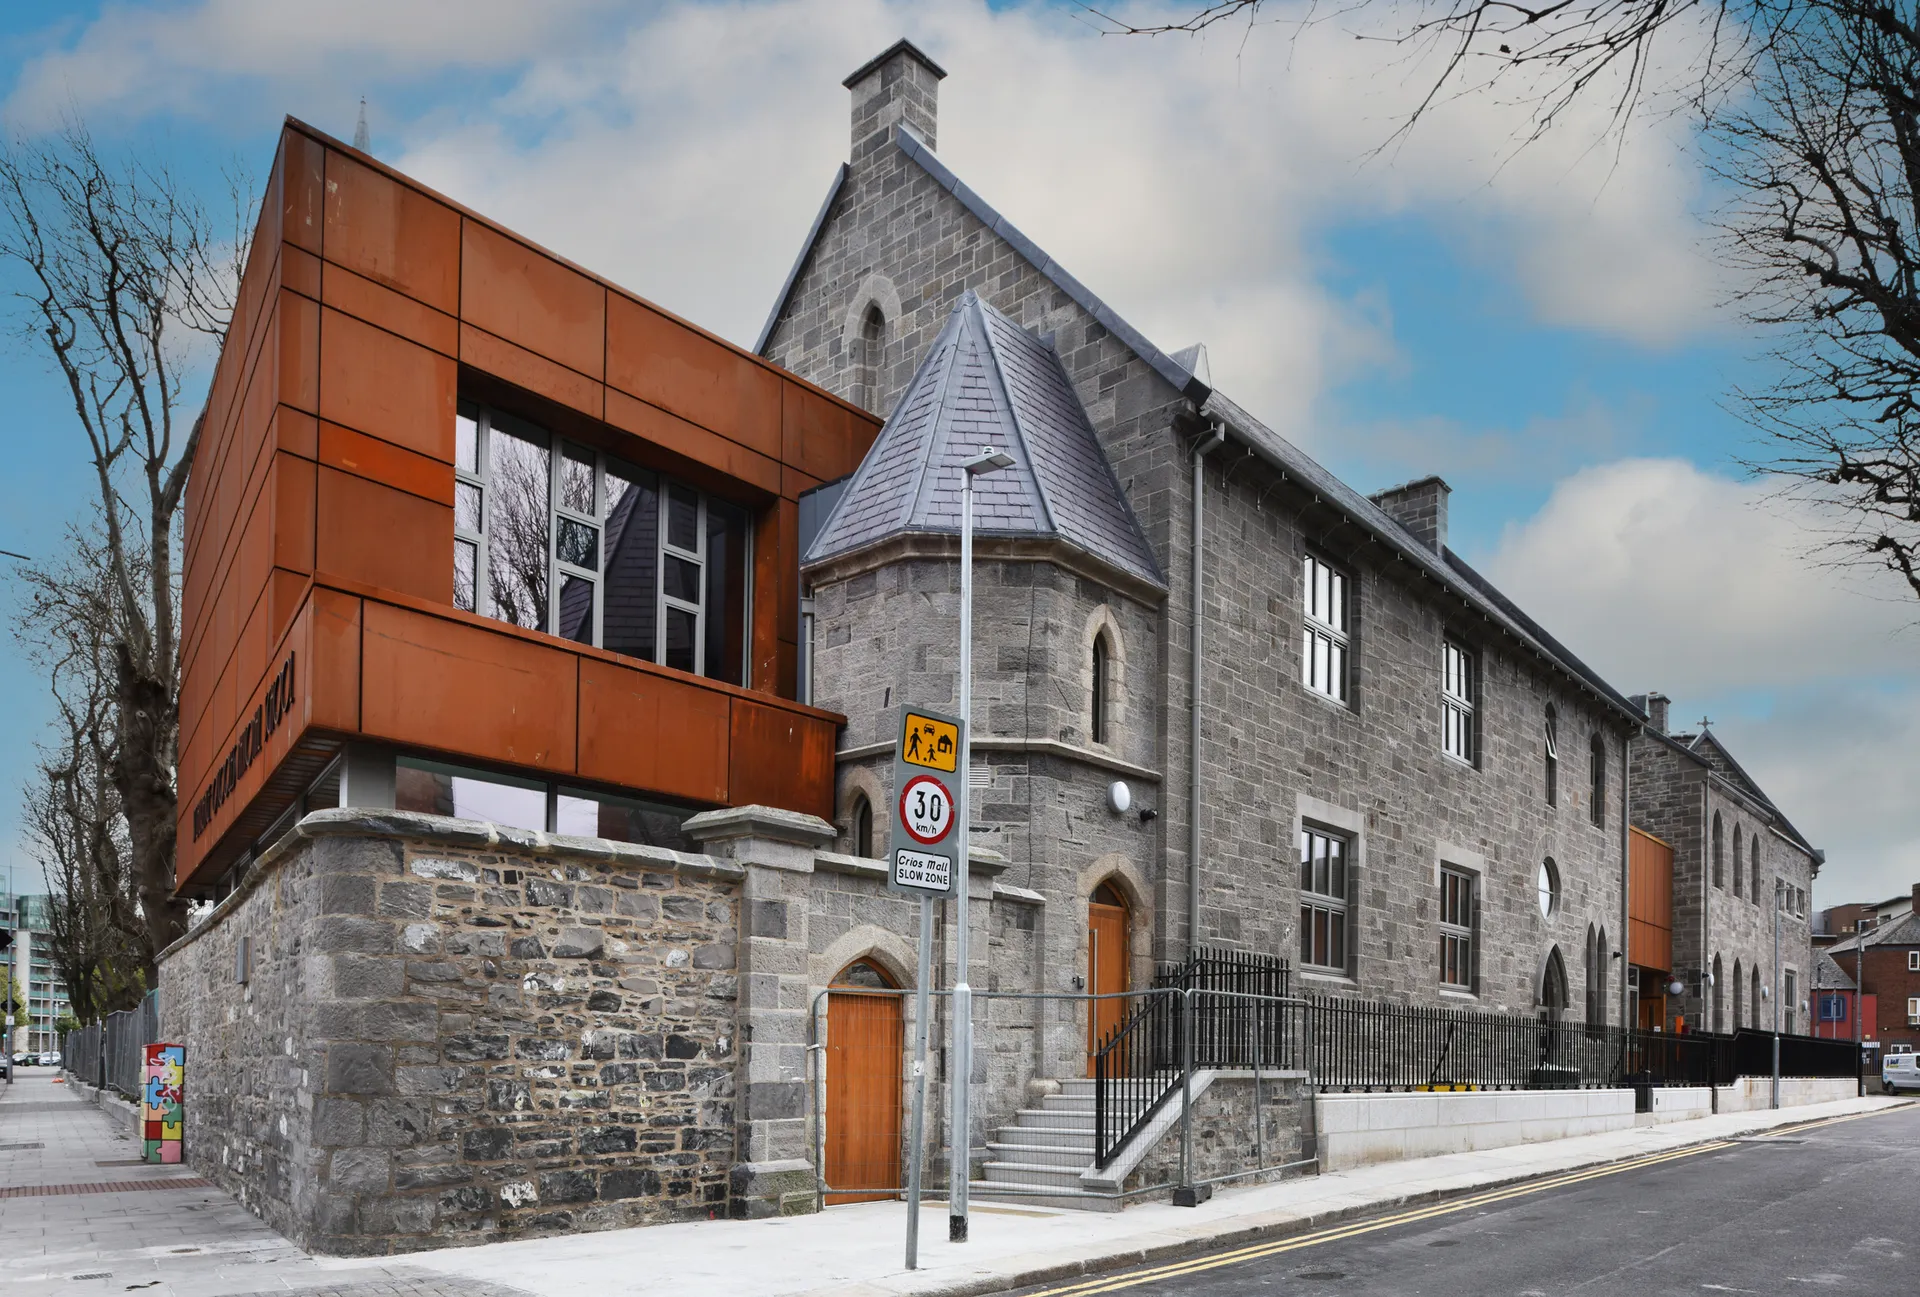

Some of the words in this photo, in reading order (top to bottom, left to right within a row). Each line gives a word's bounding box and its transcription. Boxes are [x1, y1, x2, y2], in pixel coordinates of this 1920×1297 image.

[914, 790, 942, 822] 30
[915, 822, 937, 835] km/h
[898, 855, 924, 868] Crios
[926, 859, 948, 872] Mall
[898, 868, 924, 881] SLOW
[925, 872, 948, 885] ZONE
